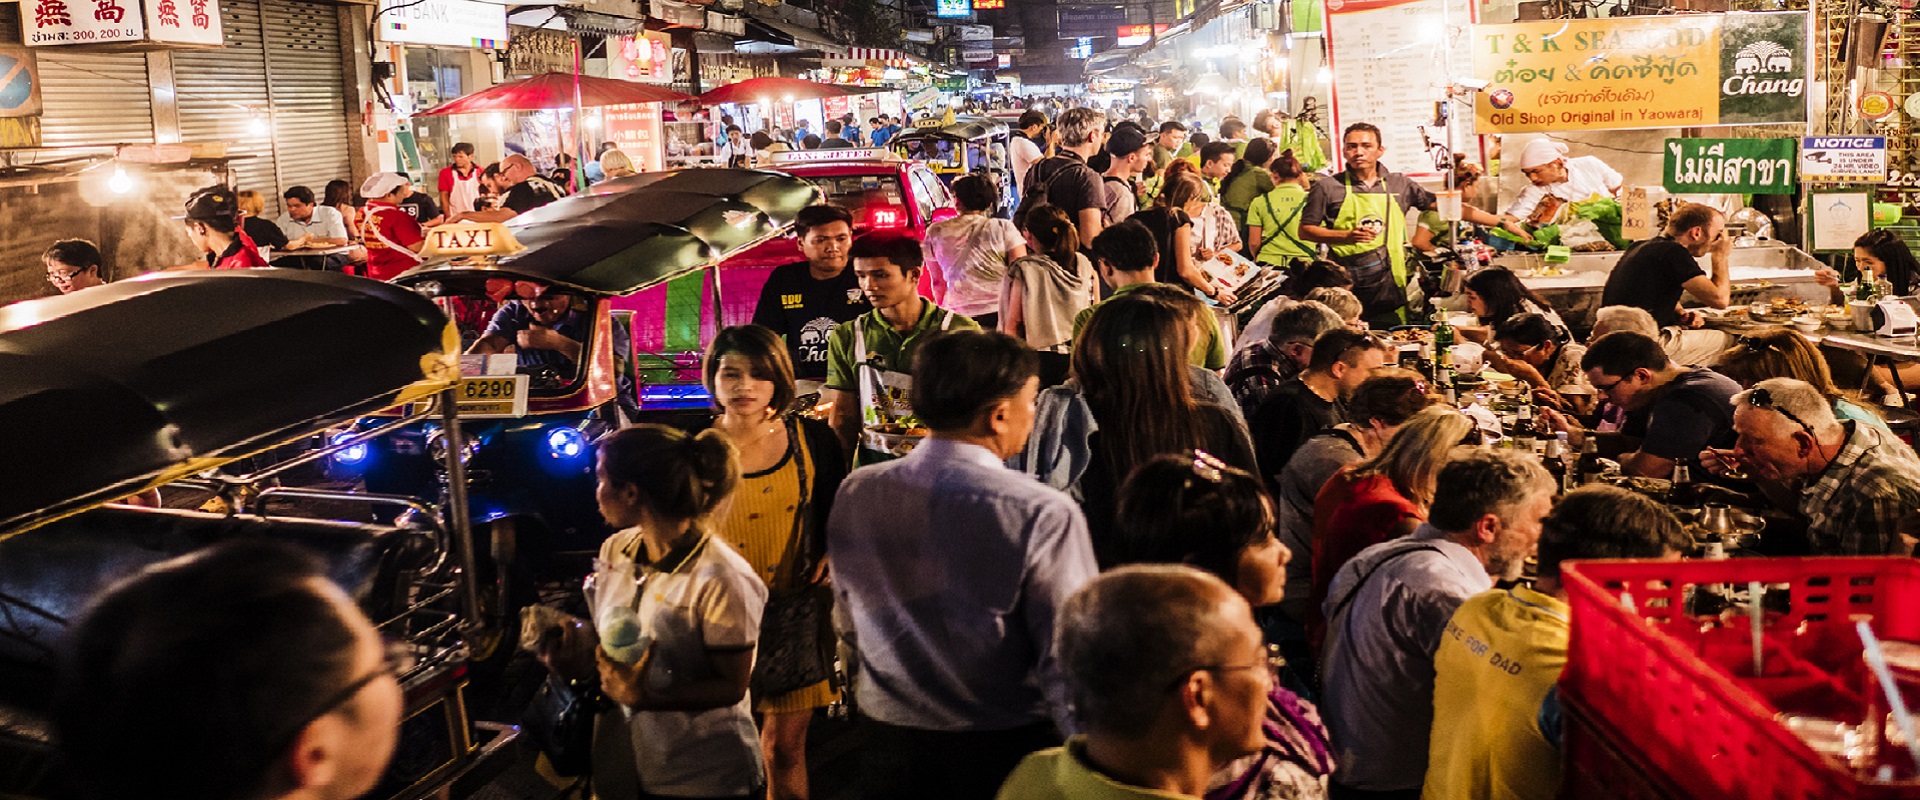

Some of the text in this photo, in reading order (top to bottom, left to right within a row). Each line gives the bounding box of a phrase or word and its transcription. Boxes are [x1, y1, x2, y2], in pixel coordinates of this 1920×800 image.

[413, 3, 449, 23] BANK
[100, 29, 120, 38] 200
[1485, 33, 1504, 54] T
[1512, 33, 1532, 53] &
[1541, 32, 1562, 53] K
[1564, 64, 1581, 81] &
[1723, 75, 1804, 97] Chang
[1490, 107, 1703, 126] Old Shop Original in Yaowaraj
[1814, 138, 1875, 148] NOTICE
[1669, 142, 1790, 186] ไม่มีสาขา
[432, 229, 492, 248] TAXI
[466, 380, 514, 397] 6290
[1465, 635, 1488, 657] FOR
[1489, 652, 1522, 675] DAD
